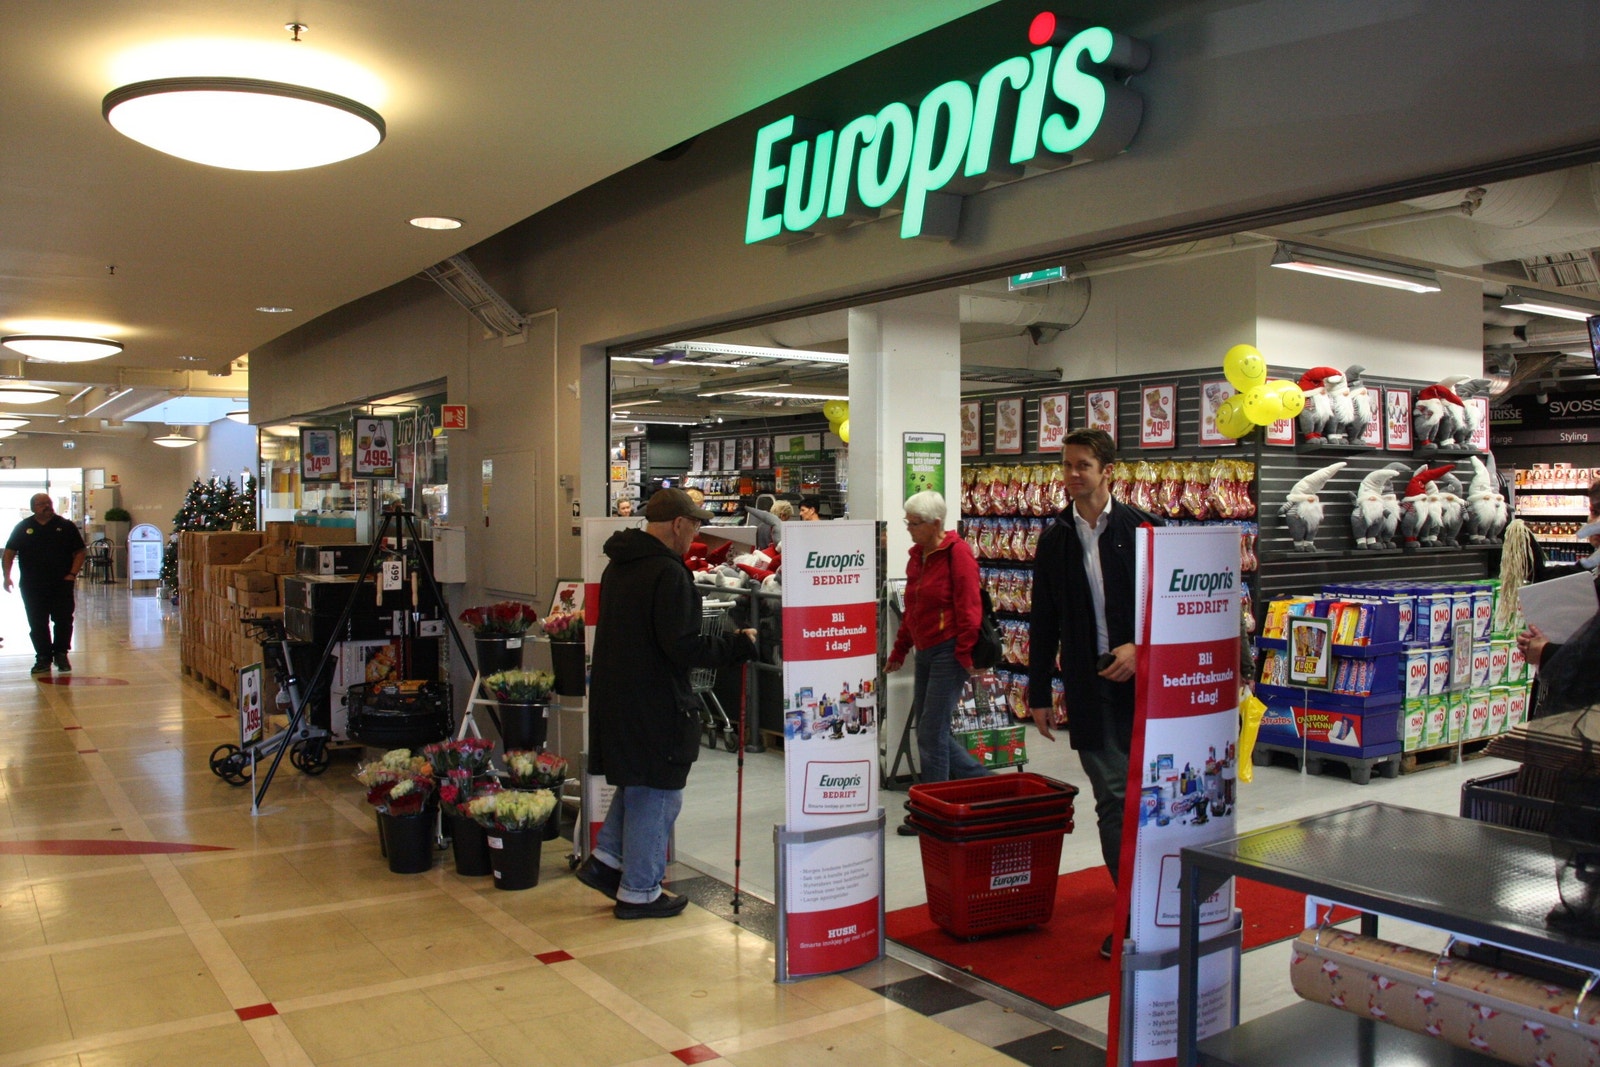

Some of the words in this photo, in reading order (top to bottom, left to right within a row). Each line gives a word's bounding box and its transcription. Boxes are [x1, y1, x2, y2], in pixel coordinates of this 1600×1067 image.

[745, 11, 1113, 244] Europris
[1489, 409, 1522, 419] TRISSE
[1560, 432, 1588, 443] Styling
[806, 550, 865, 572] Europris
[391, 564, 399, 581] 499
[812, 574, 860, 586] BEDRIFT
[1169, 566, 1233, 597] Europris
[1177, 599, 1229, 615] BEDRIFT
[1477, 606, 1489, 618] OMO
[832, 613, 845, 622] Bli
[1434, 609, 1449, 622] OMO
[1456, 608, 1470, 620] OMO
[803, 625, 867, 638] bedriftskunde
[826, 642, 829, 651] i
[831, 640, 851, 652] dag!
[1199, 652, 1213, 665] Bli
[1475, 657, 1488, 669] OMO
[1492, 655, 1507, 667] OMO
[1411, 664, 1427, 678] OMO
[1434, 661, 1449, 675] OMO
[1163, 668, 1233, 687] bedriftskunde
[1191, 692, 1195, 704] i
[1197, 688, 1218, 705] dag!
[1492, 704, 1506, 717] OMO
[1511, 700, 1524, 712] OMO
[1434, 712, 1444, 722] OMO
[1472, 707, 1488, 720] OMO
[1260, 716, 1292, 726] Stratos
[1412, 716, 1423, 726] OMO
[819, 774, 861, 790] Europris
[823, 790, 857, 799] BEDRIFT
[992, 873, 1029, 886] Europris
